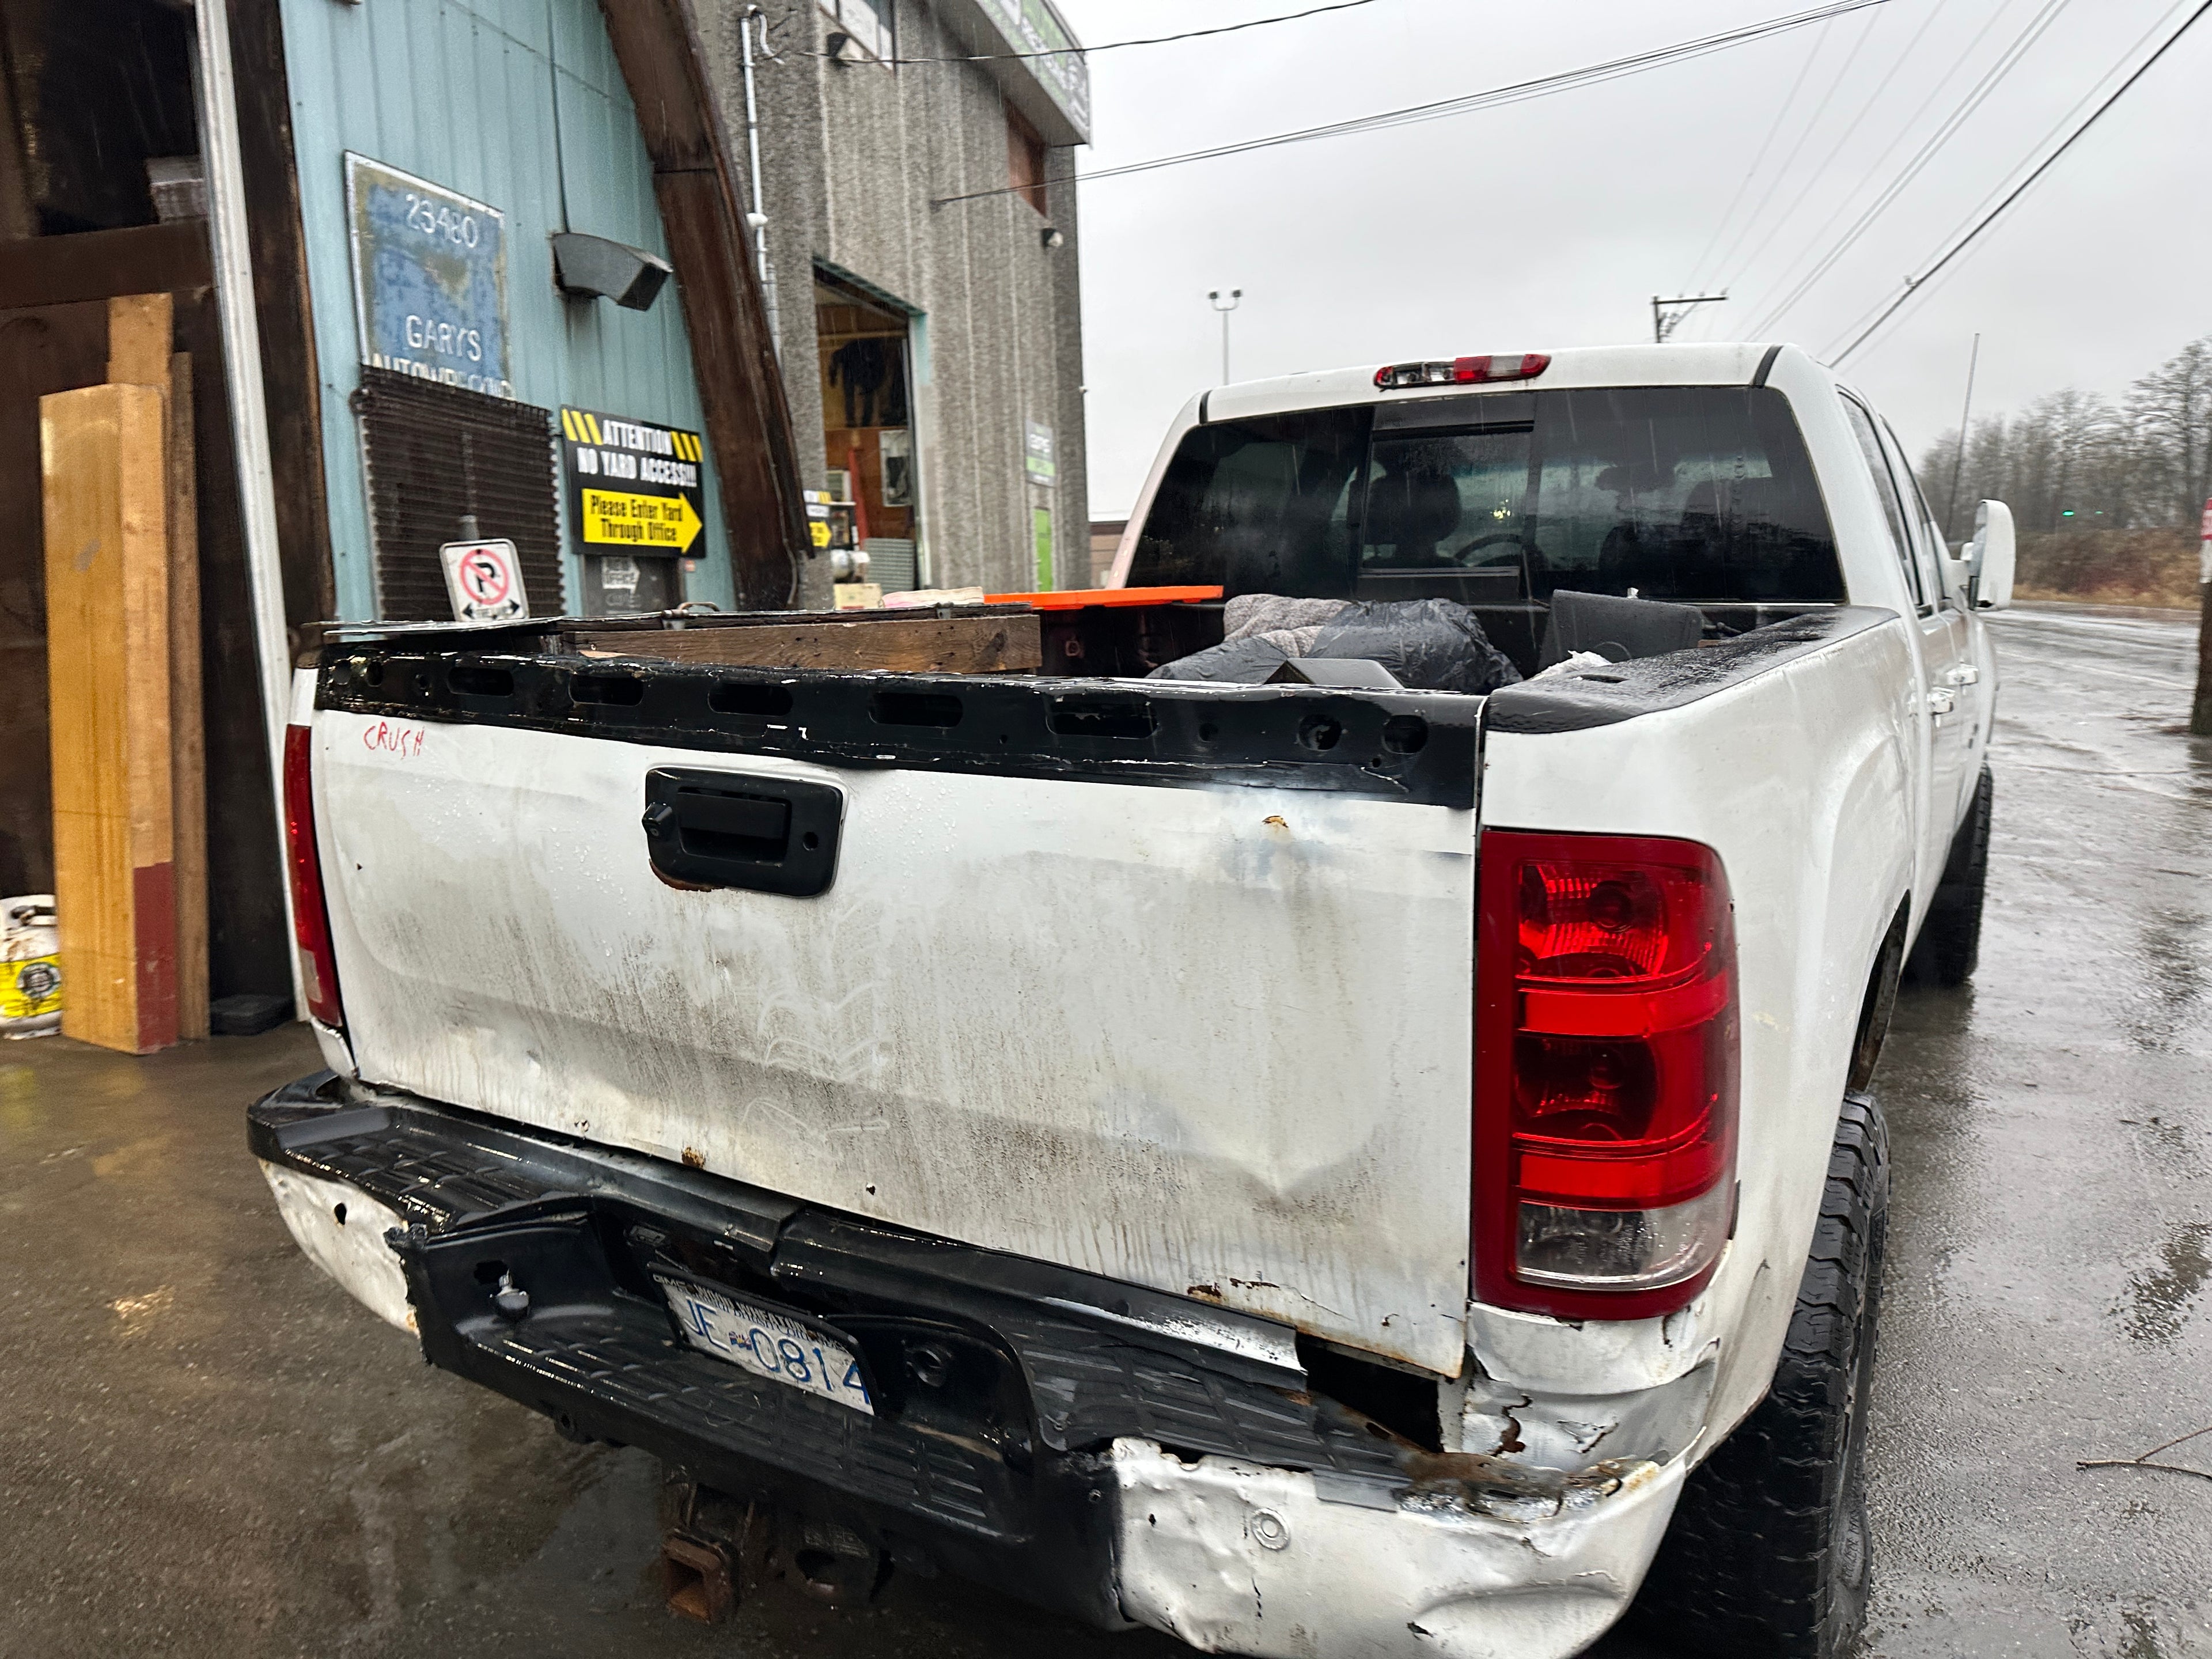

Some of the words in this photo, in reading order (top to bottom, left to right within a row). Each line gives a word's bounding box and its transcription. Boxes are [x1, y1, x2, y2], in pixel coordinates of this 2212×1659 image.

[406, 194, 479, 248] 23480
[603, 419, 673, 455] ATTENTION
[577, 446, 599, 475] NO
[600, 450, 637, 479] YARD
[590, 494, 627, 517] Please
[630, 498, 658, 520] Enter
[662, 502, 683, 522] Yard
[600, 518, 645, 542] Through
[647, 521, 677, 541] Office
[363, 722, 425, 760] CRUSH
